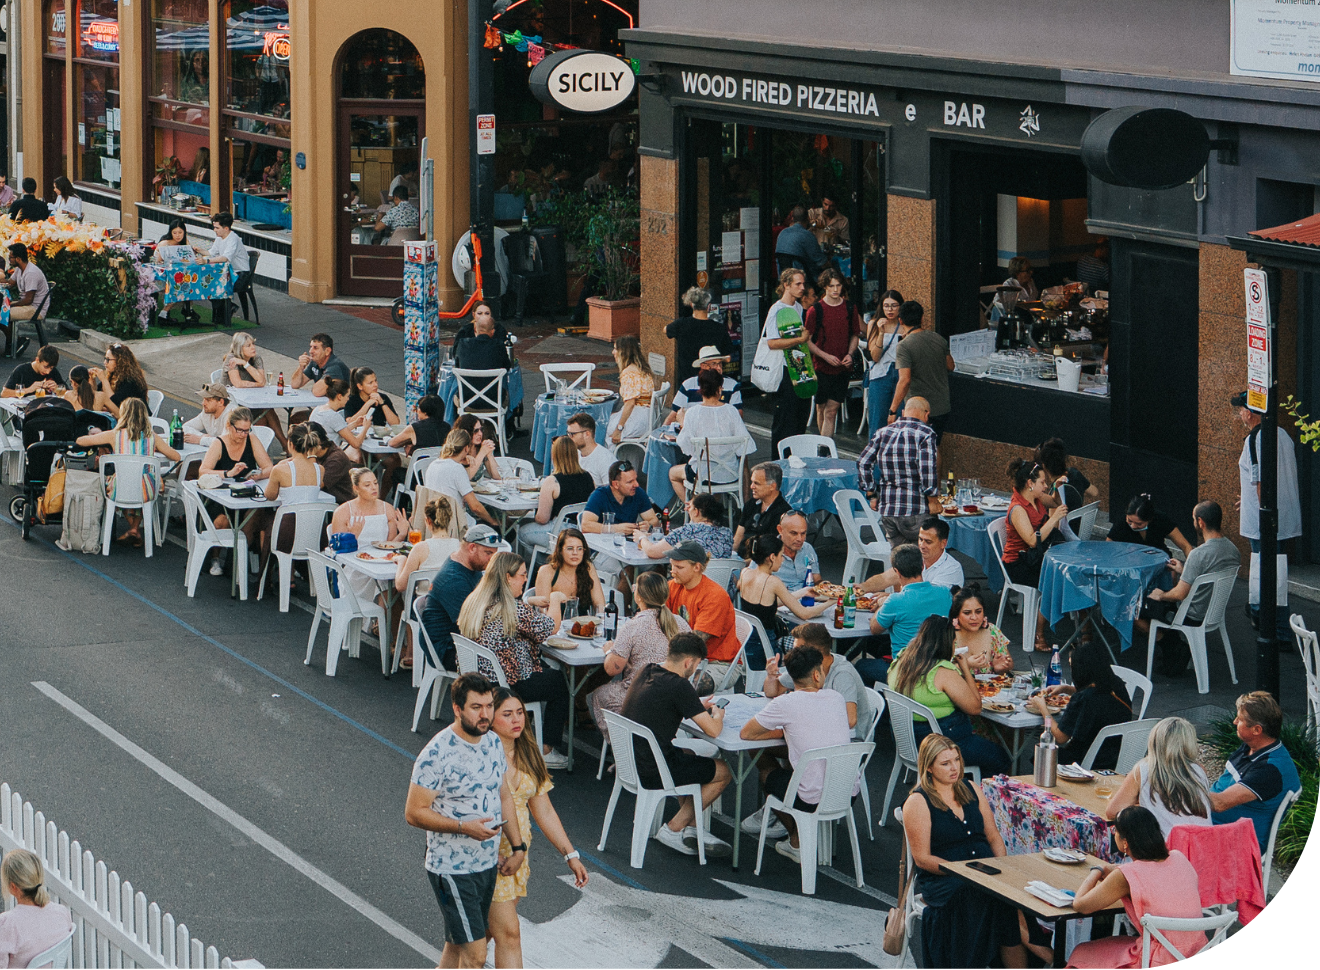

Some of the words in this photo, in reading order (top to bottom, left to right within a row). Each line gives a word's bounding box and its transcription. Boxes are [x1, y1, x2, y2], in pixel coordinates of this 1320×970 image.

[558, 71, 625, 93] SICILY
[681, 71, 738, 99] WOOD
[742, 78, 793, 106] FIRED
[797, 83, 880, 117] PIZZERIA
[905, 103, 917, 121] e
[943, 100, 986, 129] BAR
[1251, 337, 1264, 350] ZONE
